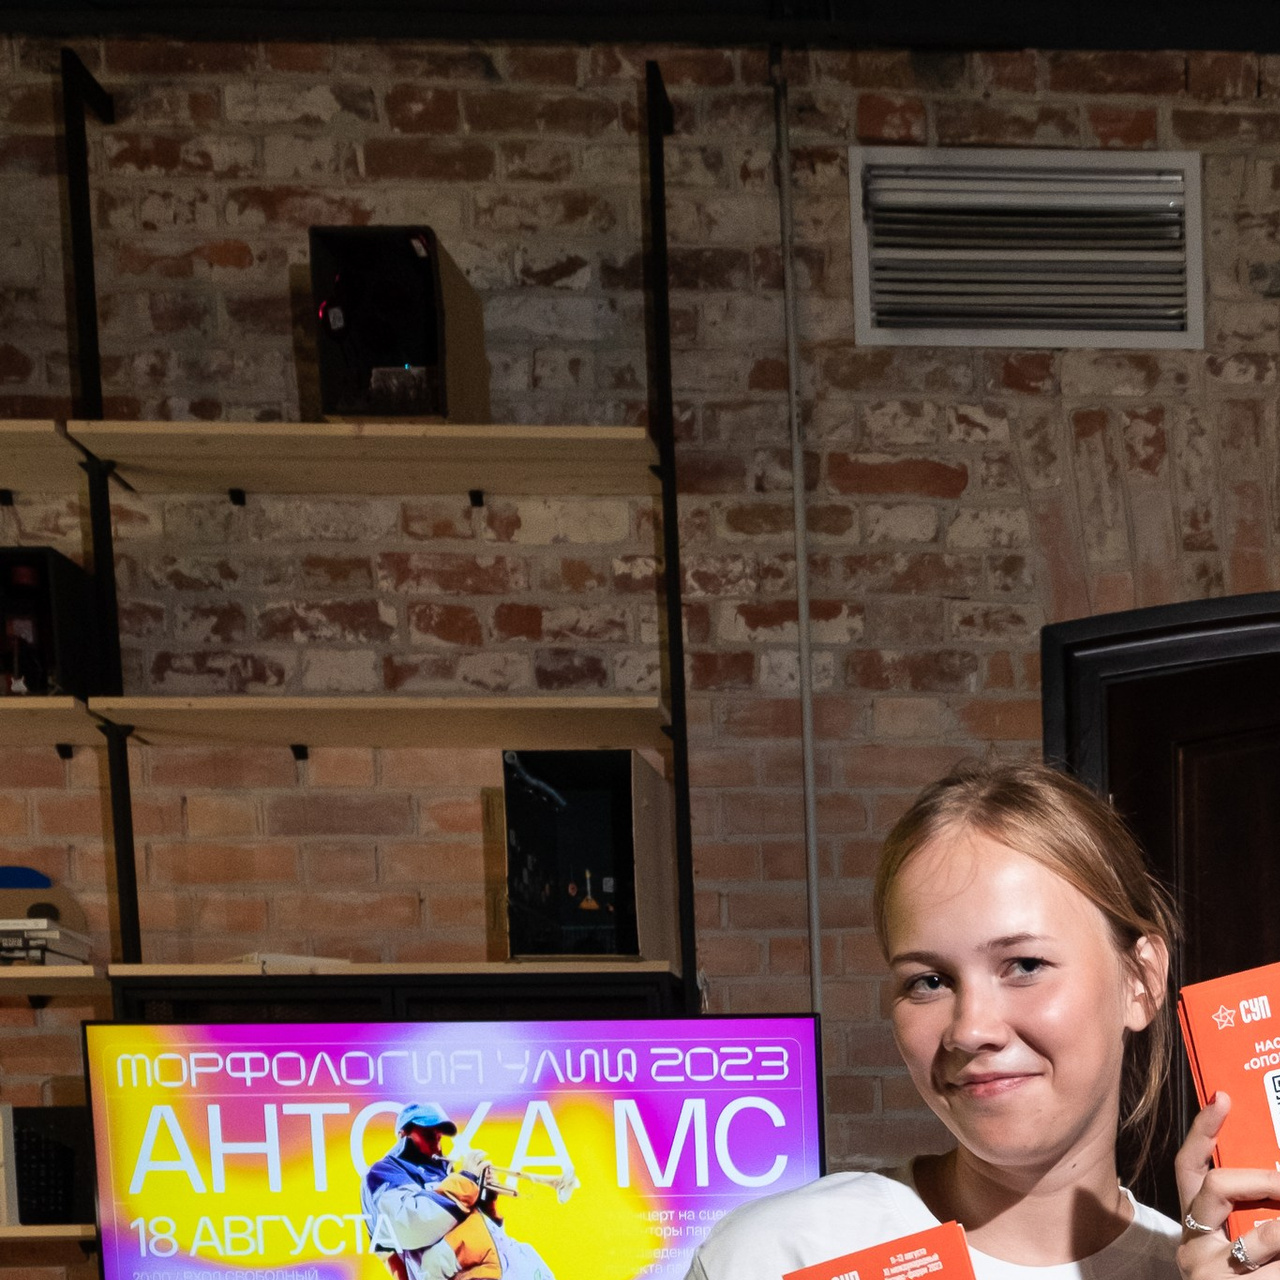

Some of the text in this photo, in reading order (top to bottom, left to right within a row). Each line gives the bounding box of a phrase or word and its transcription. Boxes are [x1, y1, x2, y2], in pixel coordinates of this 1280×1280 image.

[1239, 995, 1272, 1024] СУП
[650, 1046, 789, 1082] 2023
[613, 1096, 788, 1188] МС
[129, 1213, 404, 1258] 18 АВГУСТА
